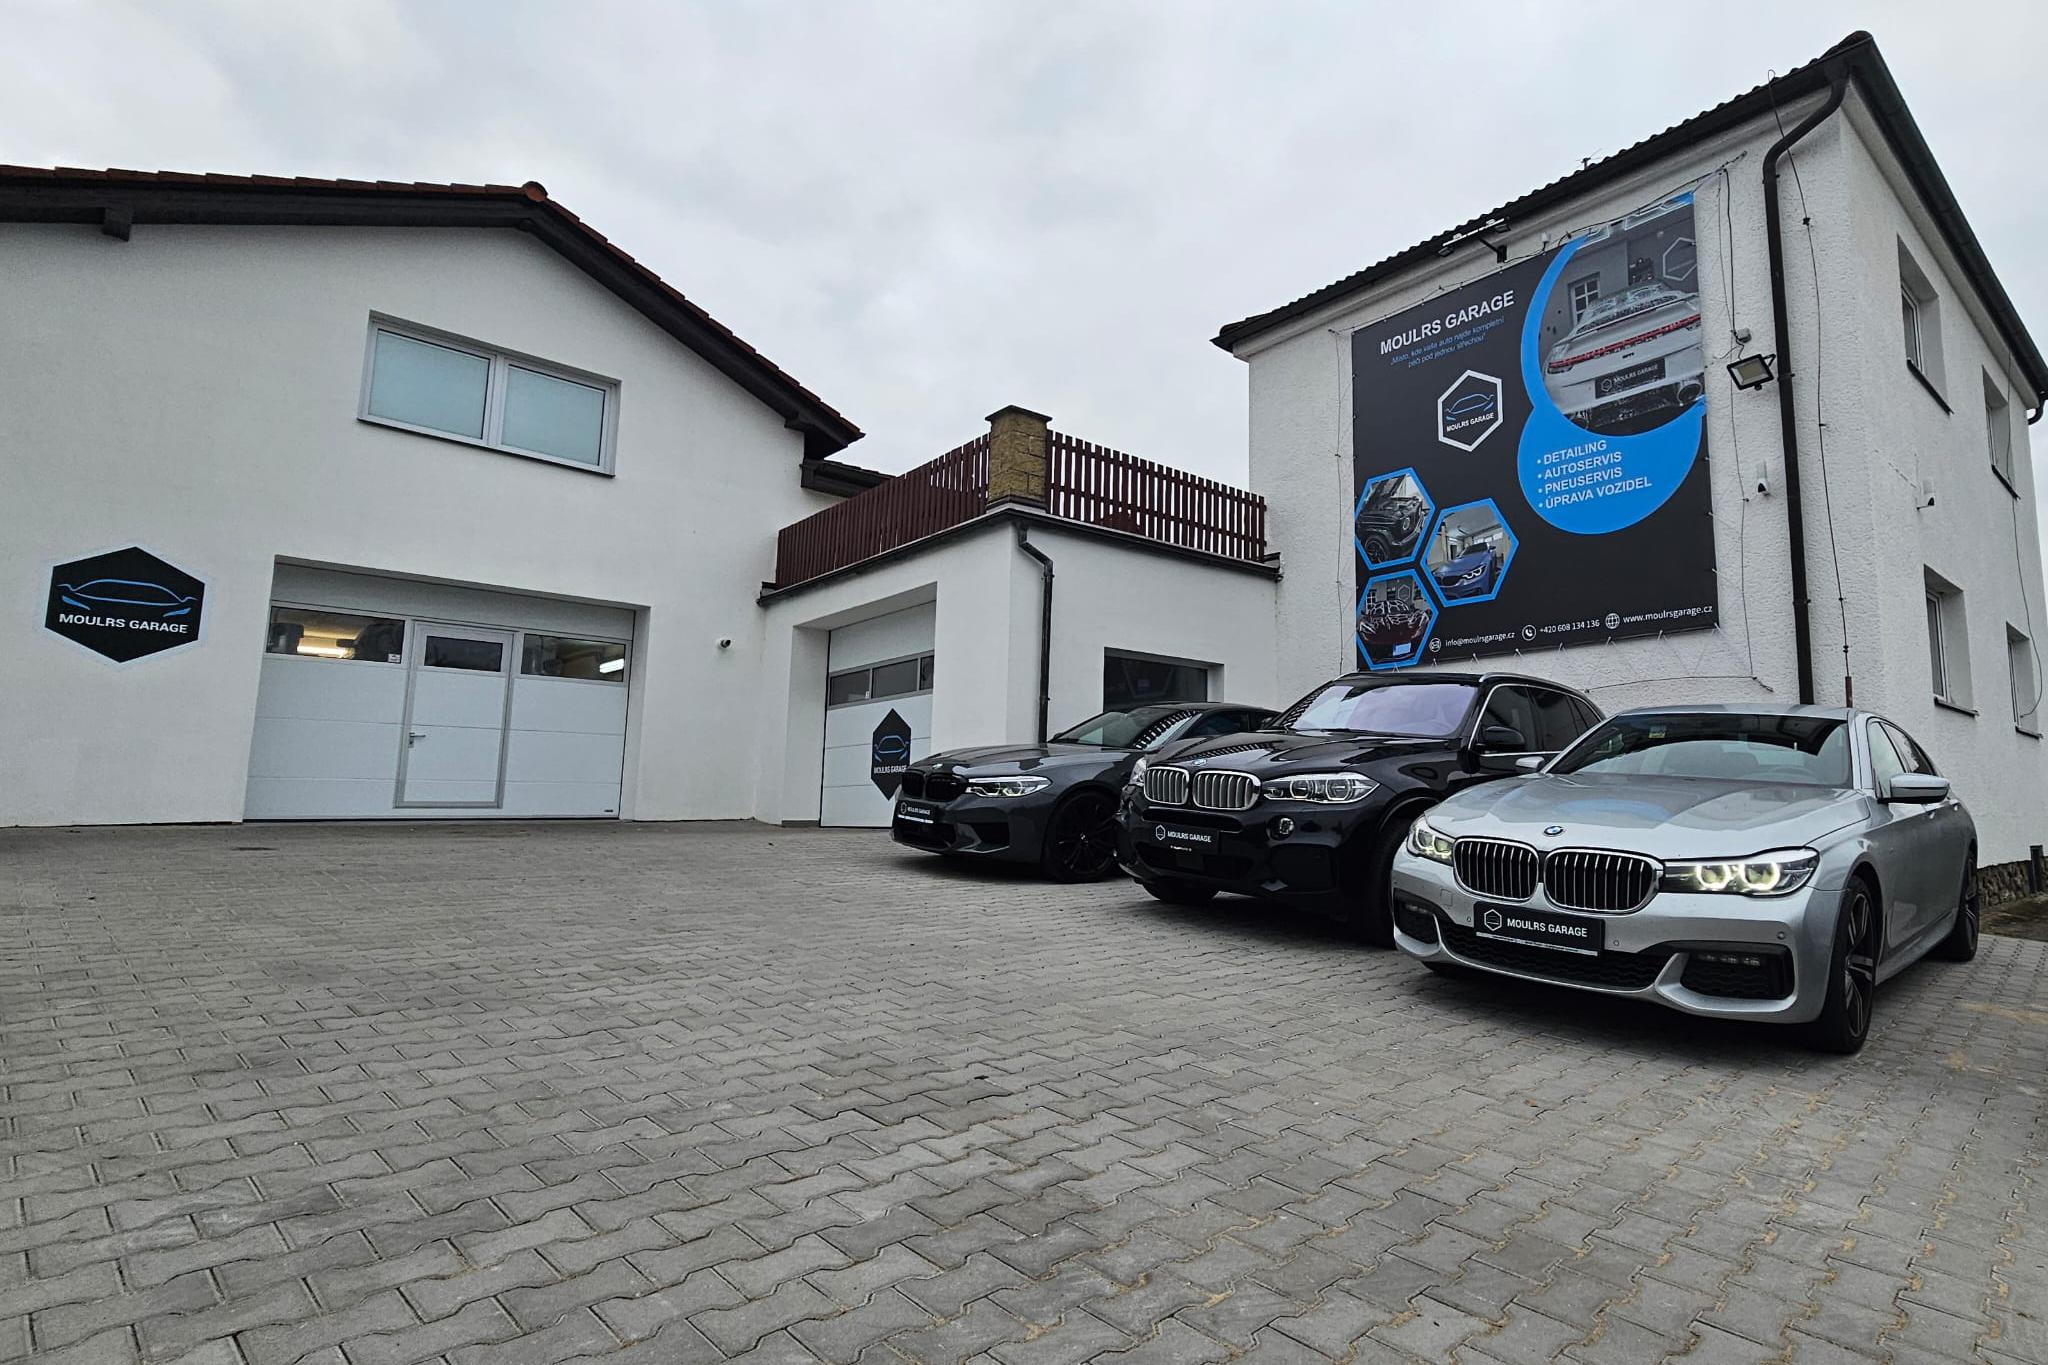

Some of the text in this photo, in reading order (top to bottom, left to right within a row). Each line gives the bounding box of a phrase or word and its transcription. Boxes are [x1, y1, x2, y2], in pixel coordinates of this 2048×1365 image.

[1380, 290, 1515, 355] MOULRS GARAGE
[1446, 412, 1495, 432] MOULRS GARAGE
[1543, 440, 1607, 465] DETAILING
[1544, 451, 1622, 480] AUTOSERVIS
[1545, 467, 1623, 495] PNEUSERVIS
[1545, 476, 1652, 509] ÚPRAVA VOZIDEL
[59, 613, 189, 634] MOULRS GARAGE
[1623, 605, 1713, 623] www.moulrsgarage.cz
[1539, 619, 1600, 634] +420 608 134 136
[1445, 631, 1515, 648] info@moulrsgarage.cz
[1167, 830, 1212, 843] MOULRS GARAGE
[1507, 918, 1588, 938] MOULRS GARAGE
